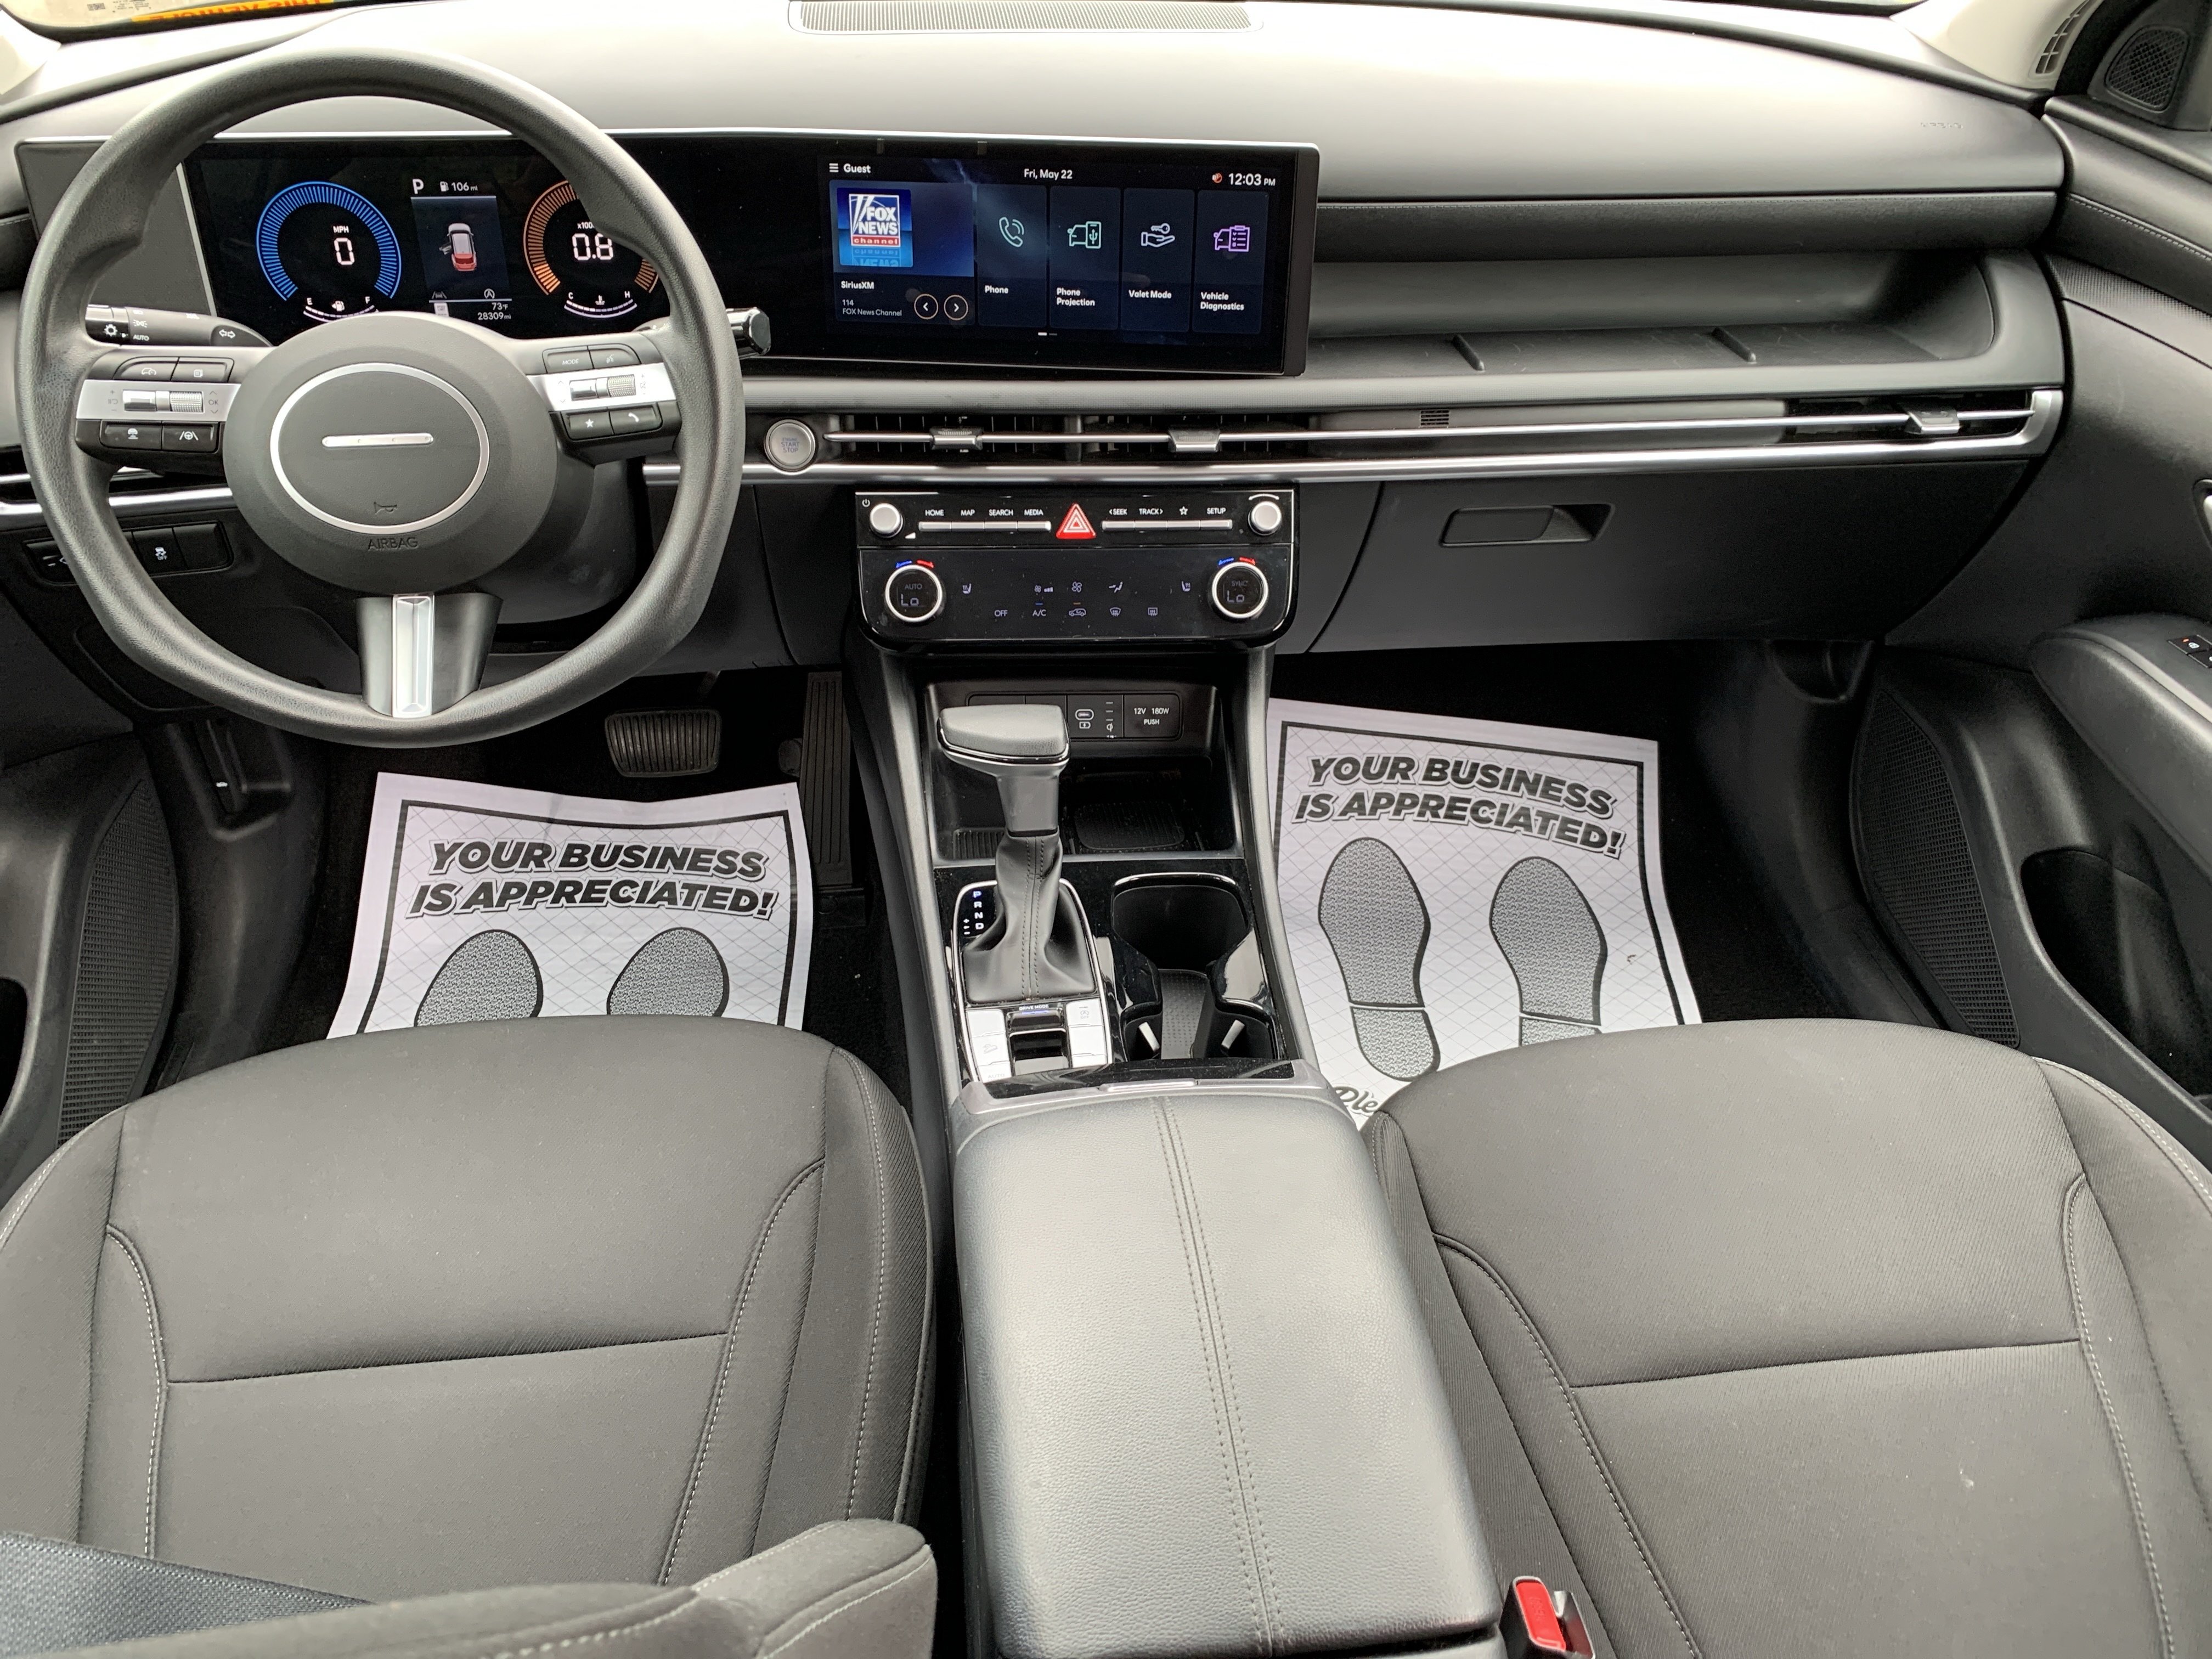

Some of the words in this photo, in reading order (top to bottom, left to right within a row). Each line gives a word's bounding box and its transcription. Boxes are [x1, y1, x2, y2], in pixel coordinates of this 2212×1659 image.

[843, 163, 871, 173] Guest
[1024, 168, 1037, 179] Fri,
[1040, 169, 1059, 180] May
[1061, 170, 1073, 179] 22
[1228, 173, 1262, 185] 12:03
[413, 178, 424, 194] P
[451, 182, 470, 191] 106
[867, 206, 896, 222] FOX
[858, 222, 898, 235] NEWS
[572, 233, 614, 260] 0.8
[854, 236, 898, 245] channel
[334, 238, 355, 265] 0
[841, 280, 874, 290] SiriusXM
[985, 285, 1008, 294] Phone
[1057, 287, 1080, 296] Phone
[1128, 290, 1149, 298] Valet
[1150, 290, 1172, 298] Mode
[1201, 292, 1229, 300] Vehicle
[1057, 297, 1095, 306] Projection
[1200, 301, 1244, 312] Diagnostics
[368, 537, 419, 550] AIRBAG
[1309, 754, 1418, 785] YOUR
[1420, 757, 1615, 817] BUSINESS
[1294, 792, 1336, 821] IS
[1335, 791, 1623, 856] APPRECIATED!
[430, 840, 554, 872] YOUR
[556, 842, 767, 880] BUSINESS
[408, 881, 461, 916] IS
[456, 879, 776, 918] APPRECIATED!
